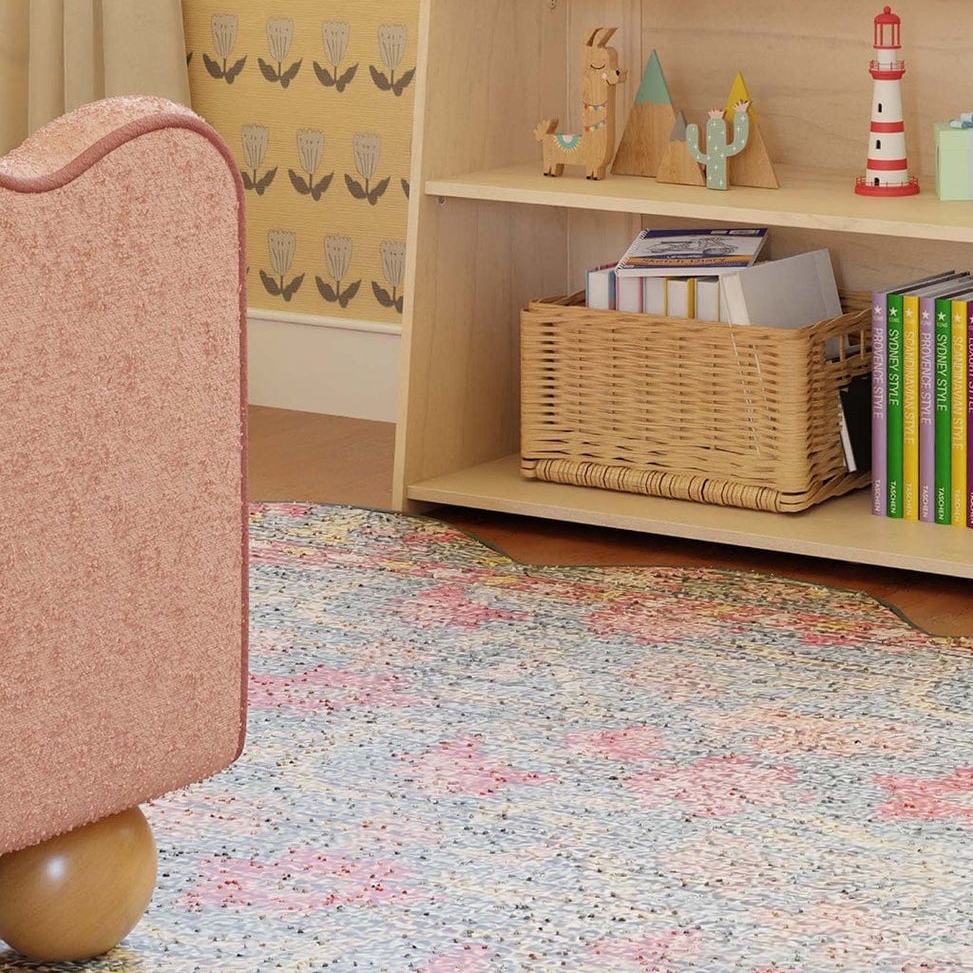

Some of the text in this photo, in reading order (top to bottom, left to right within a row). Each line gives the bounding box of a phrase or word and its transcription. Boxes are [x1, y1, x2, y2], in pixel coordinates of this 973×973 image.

[889, 329, 899, 371] SYDNEY
[921, 332, 931, 389] PROVENCE
[937, 333, 947, 377] SYDNEY
[873, 327, 883, 419] PROVENCE STYLE
[889, 373, 899, 406] STYLE
[904, 331, 915, 445] SCANDINAVIAN STYLE
[952, 336, 963, 451] SCANDINAVIAN STYLE
[921, 391, 931, 425] STYLE
[937, 378, 947, 412] STYLE
[937, 487, 945, 521] TASCHEN
